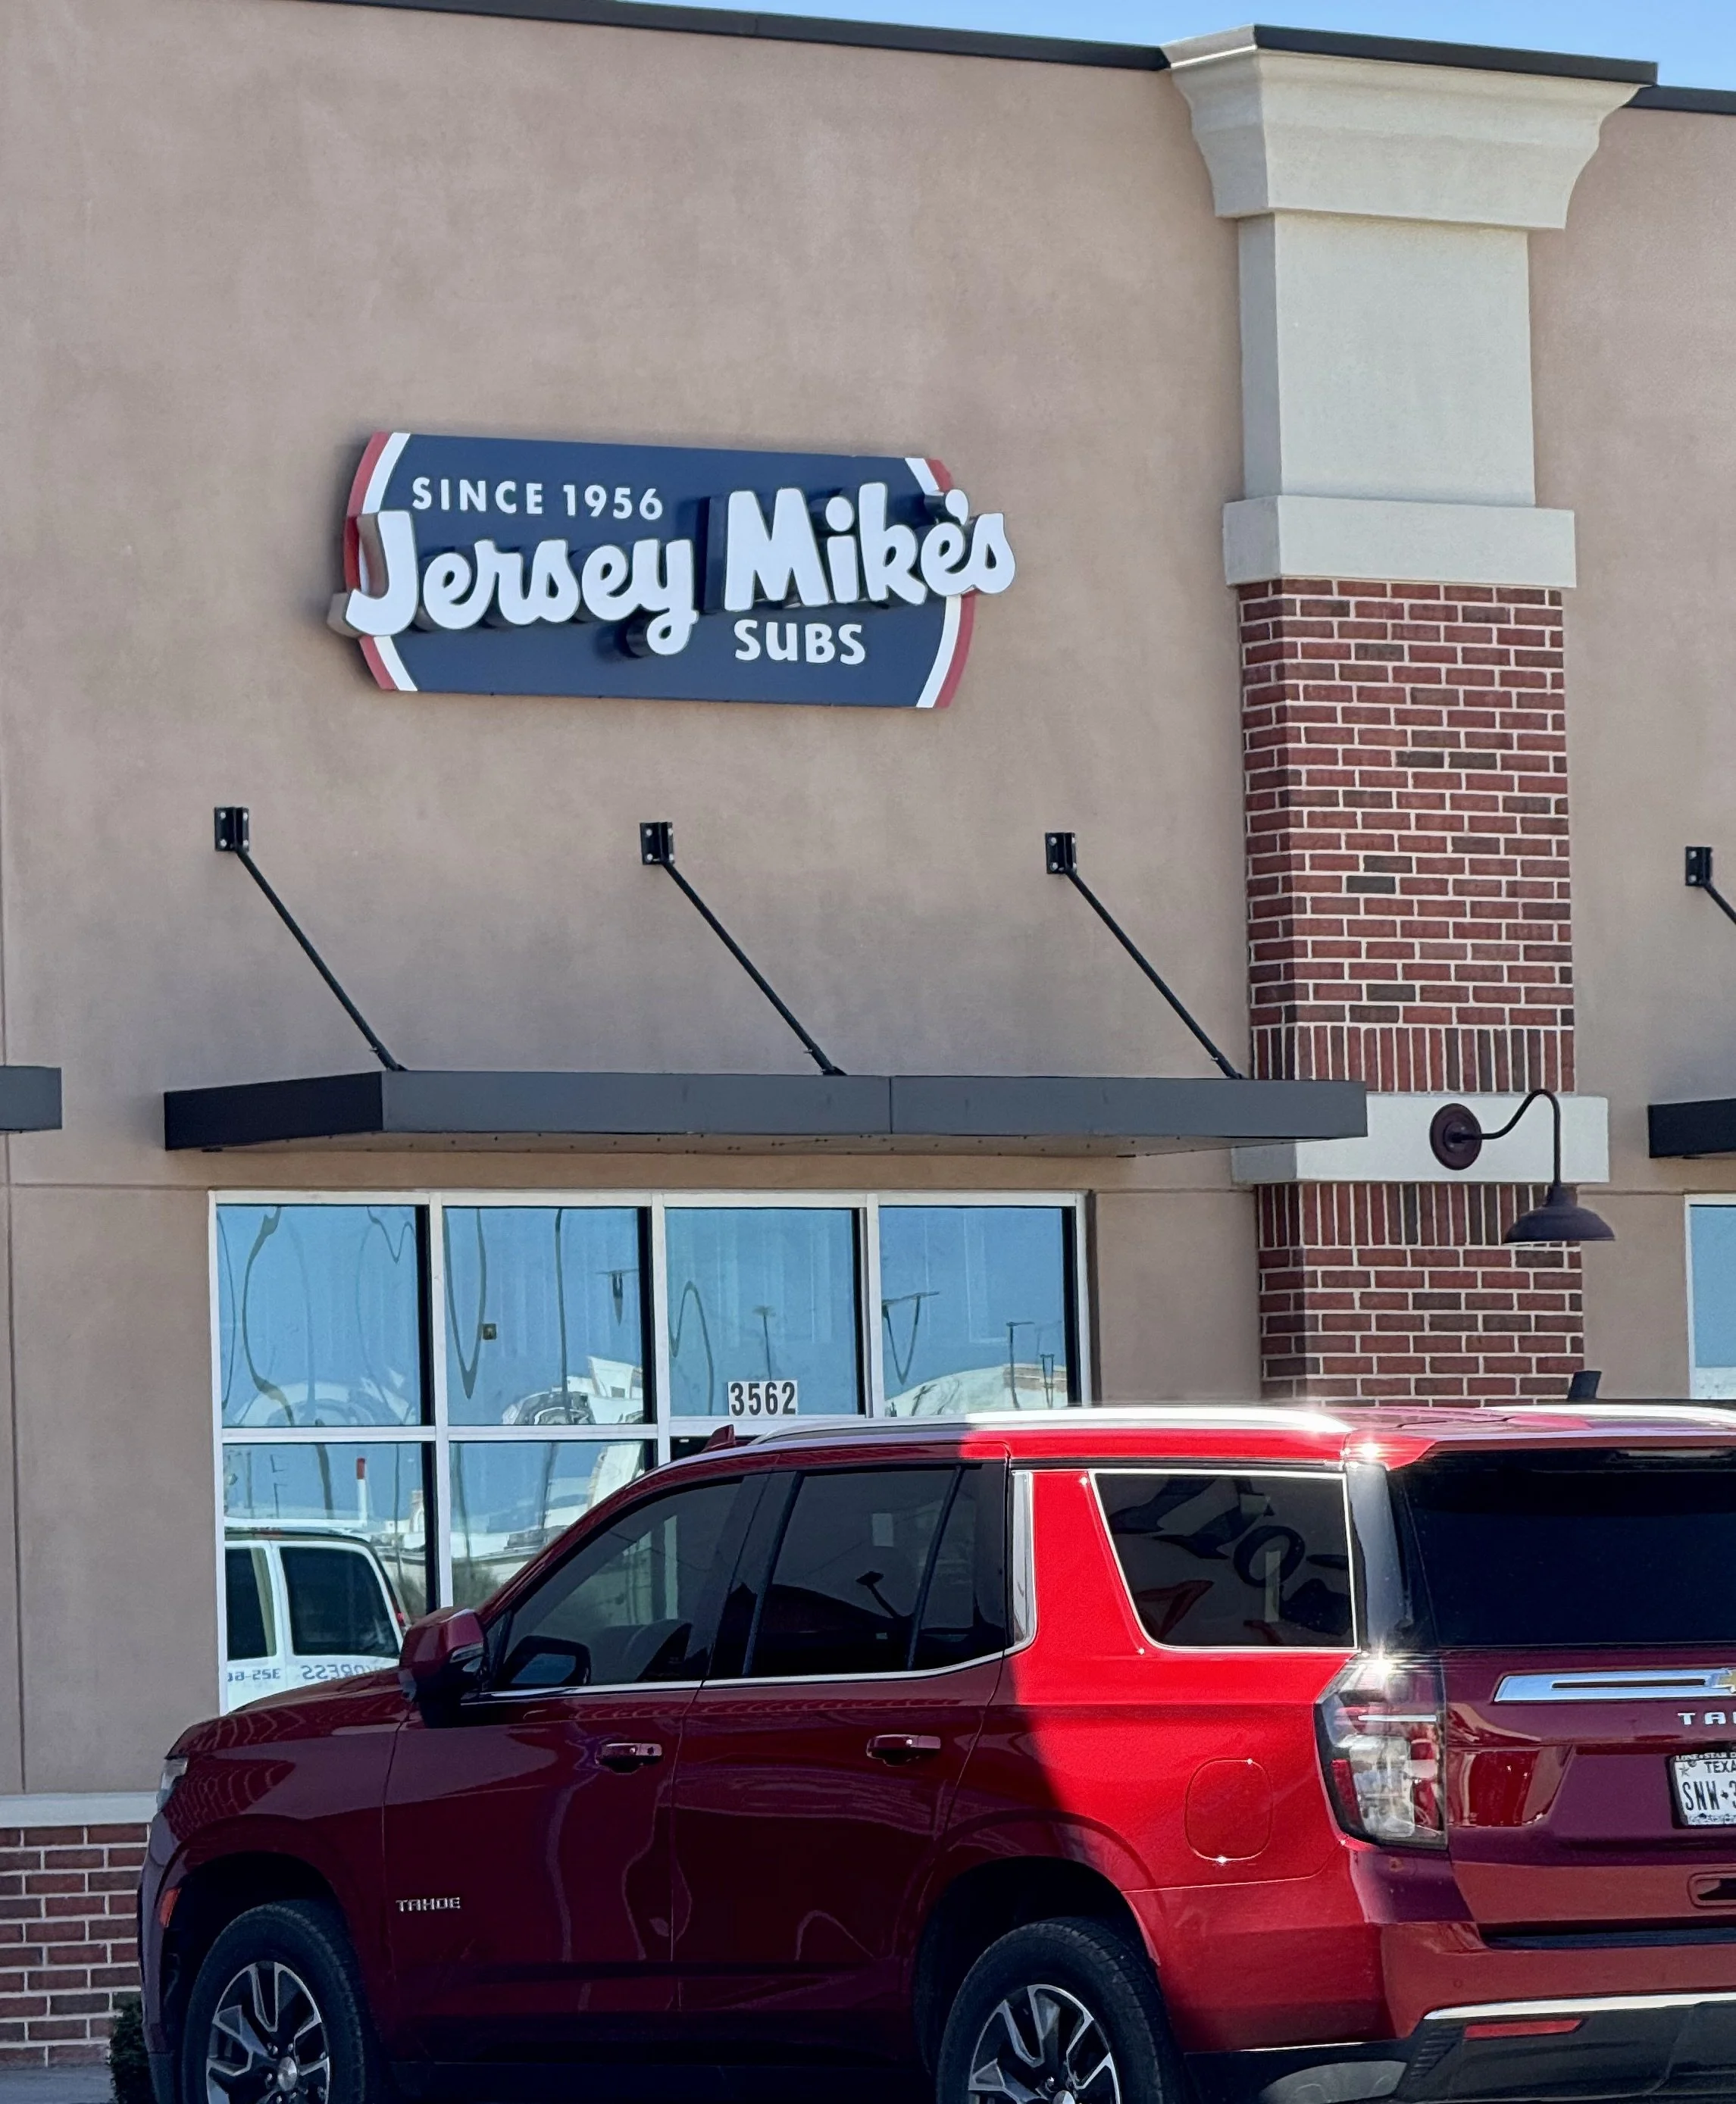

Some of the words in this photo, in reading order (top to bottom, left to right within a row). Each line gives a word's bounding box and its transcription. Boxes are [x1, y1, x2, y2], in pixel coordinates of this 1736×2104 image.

[411, 477, 543, 514] SINCE
[563, 484, 663, 521] 1956
[345, 510, 699, 655] Jersey
[724, 483, 1016, 611] Mike's
[734, 618, 865, 665] SUBS
[730, 1381, 796, 1416] 3562
[1677, 1712, 1736, 1725] TA
[395, 1897, 461, 1912] TAHOE
